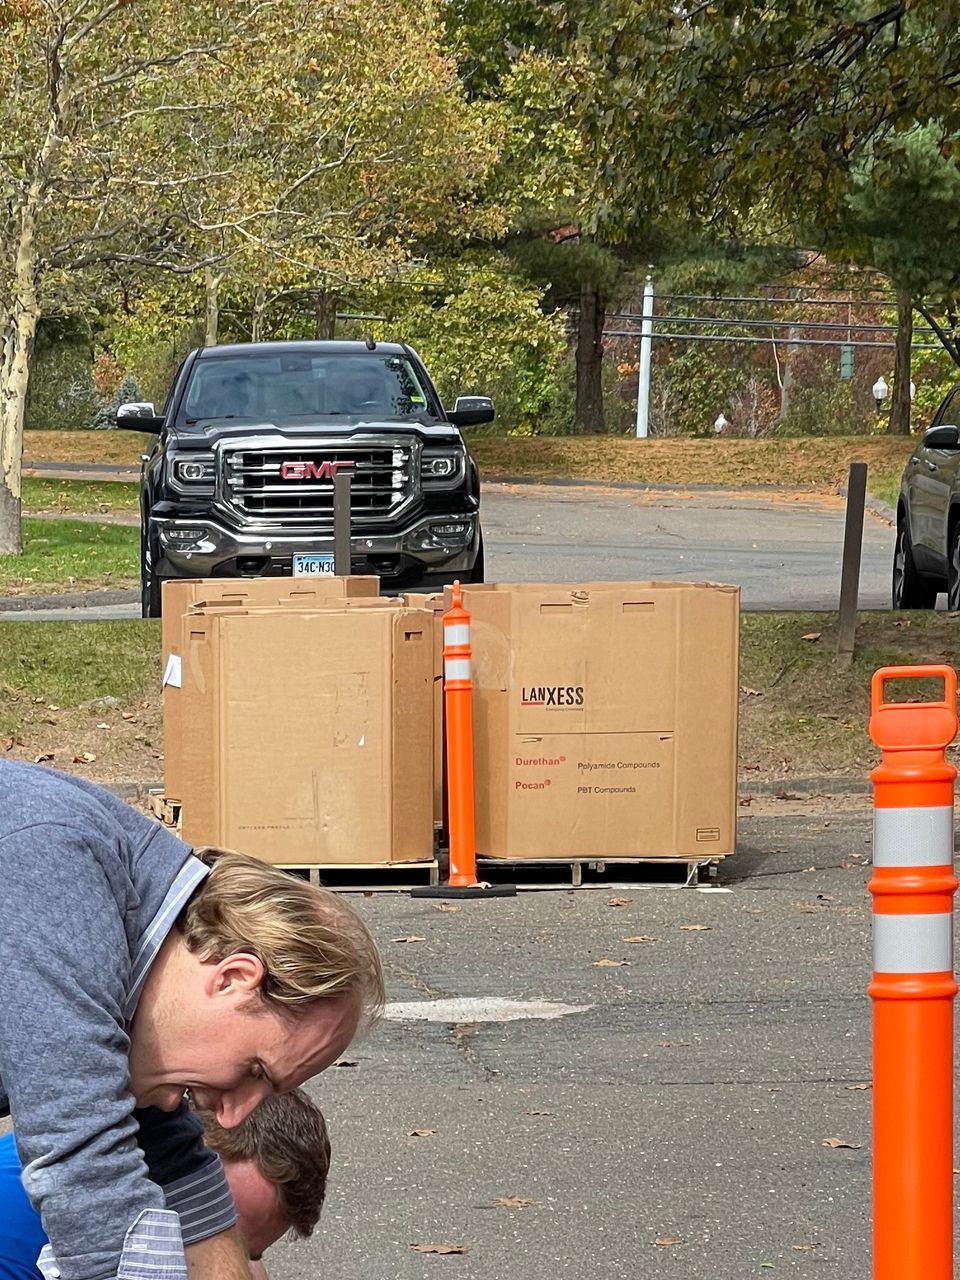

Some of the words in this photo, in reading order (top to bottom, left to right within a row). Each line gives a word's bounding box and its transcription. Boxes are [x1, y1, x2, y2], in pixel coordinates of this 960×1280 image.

[280, 461, 355, 479] GMC
[522, 686, 584, 706] LANXESS
[577, 762, 616, 771] Polyamide
[617, 761, 660, 770] Compounds
[594, 786, 636, 794] Compounds
